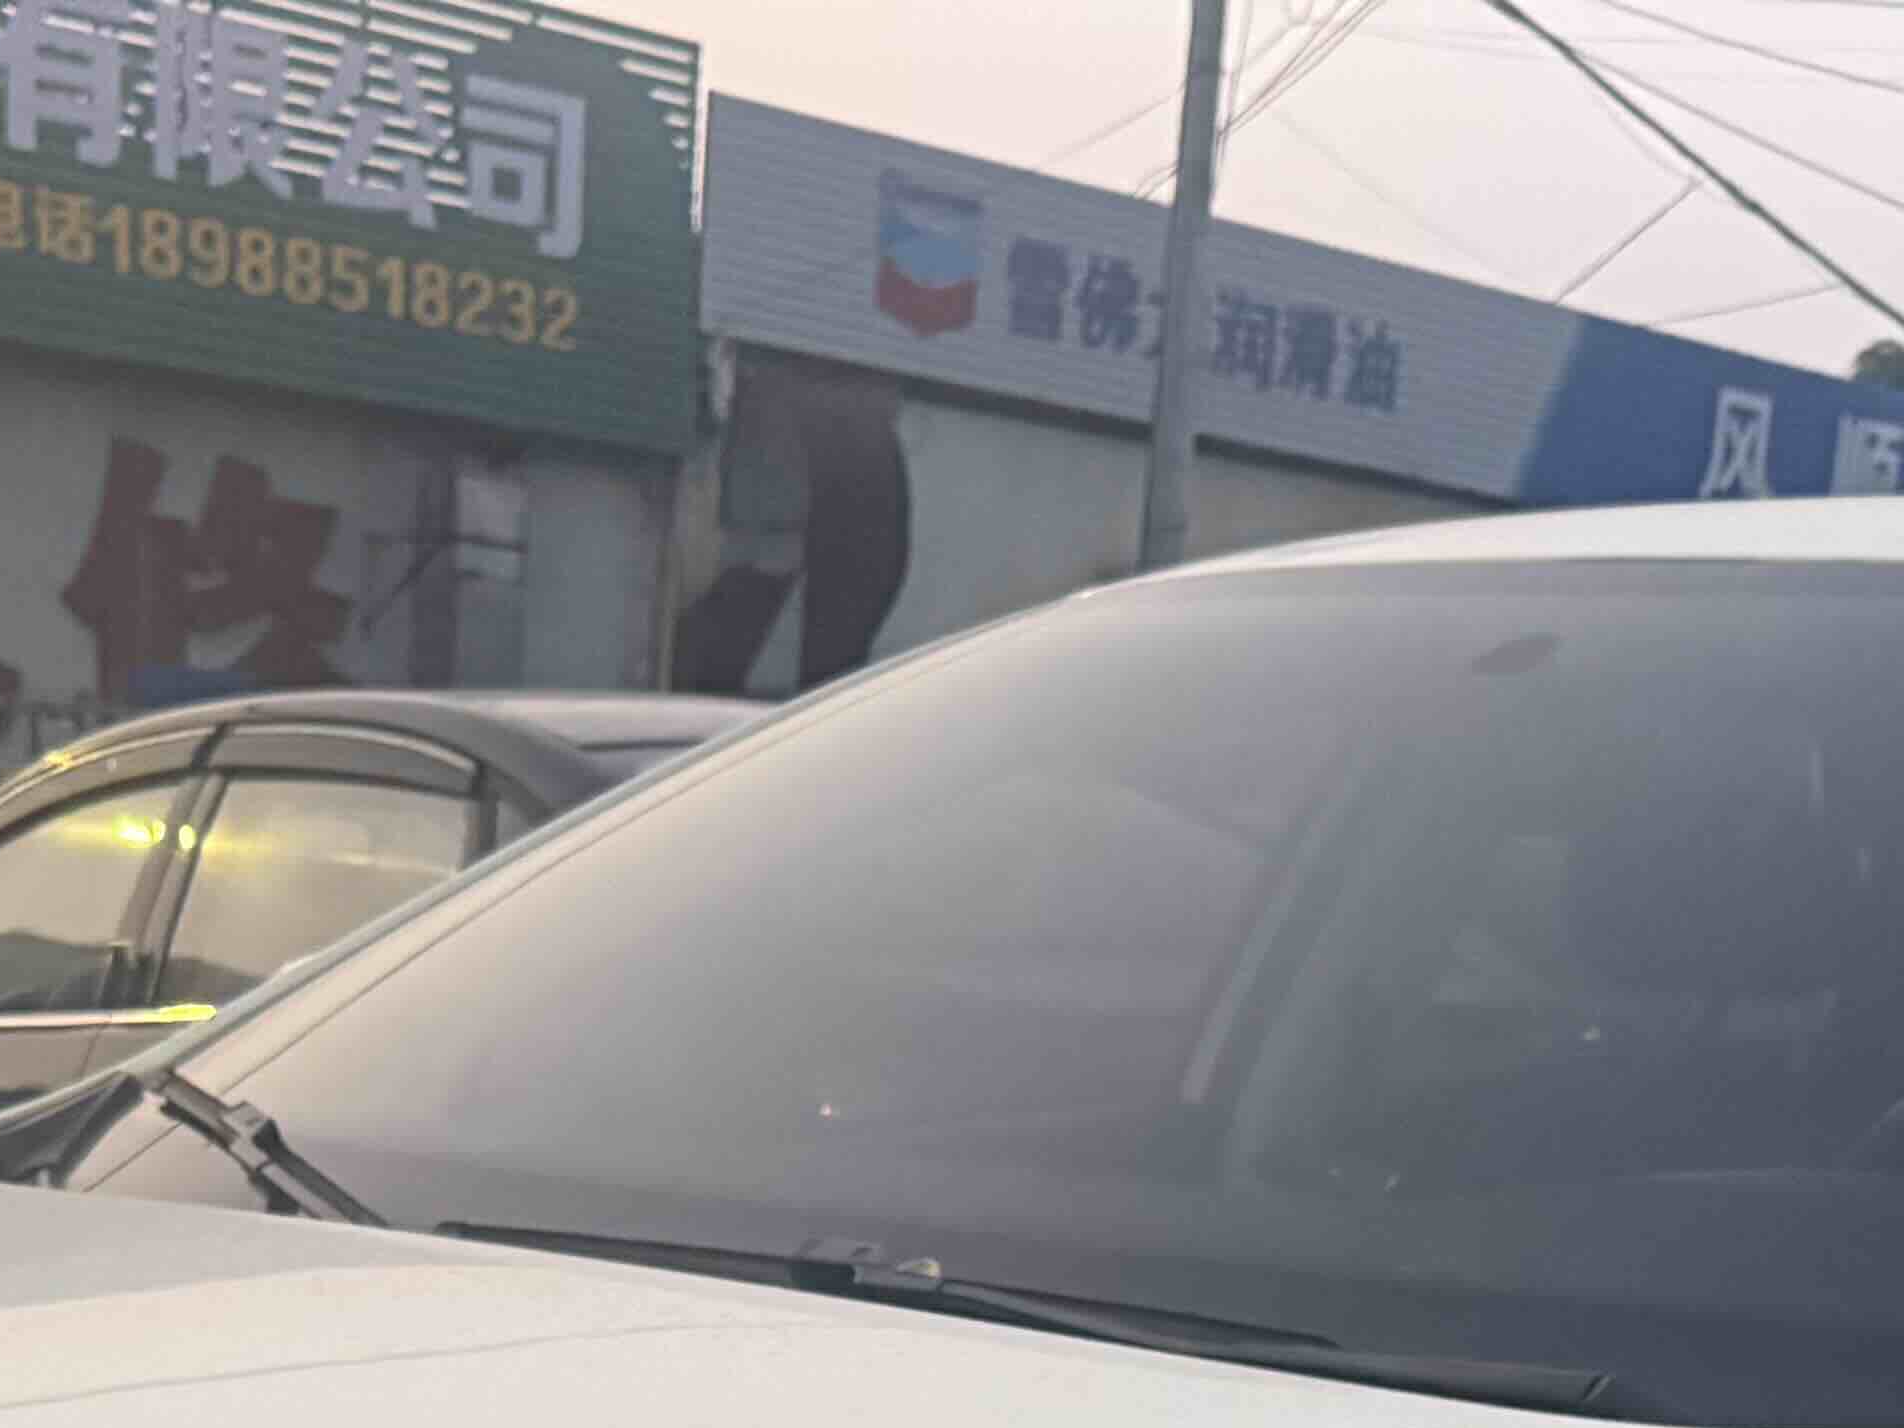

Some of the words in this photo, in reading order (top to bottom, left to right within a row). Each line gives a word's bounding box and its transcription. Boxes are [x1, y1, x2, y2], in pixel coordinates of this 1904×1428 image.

[1006, 235, 1404, 416] 雪佛润滑油
